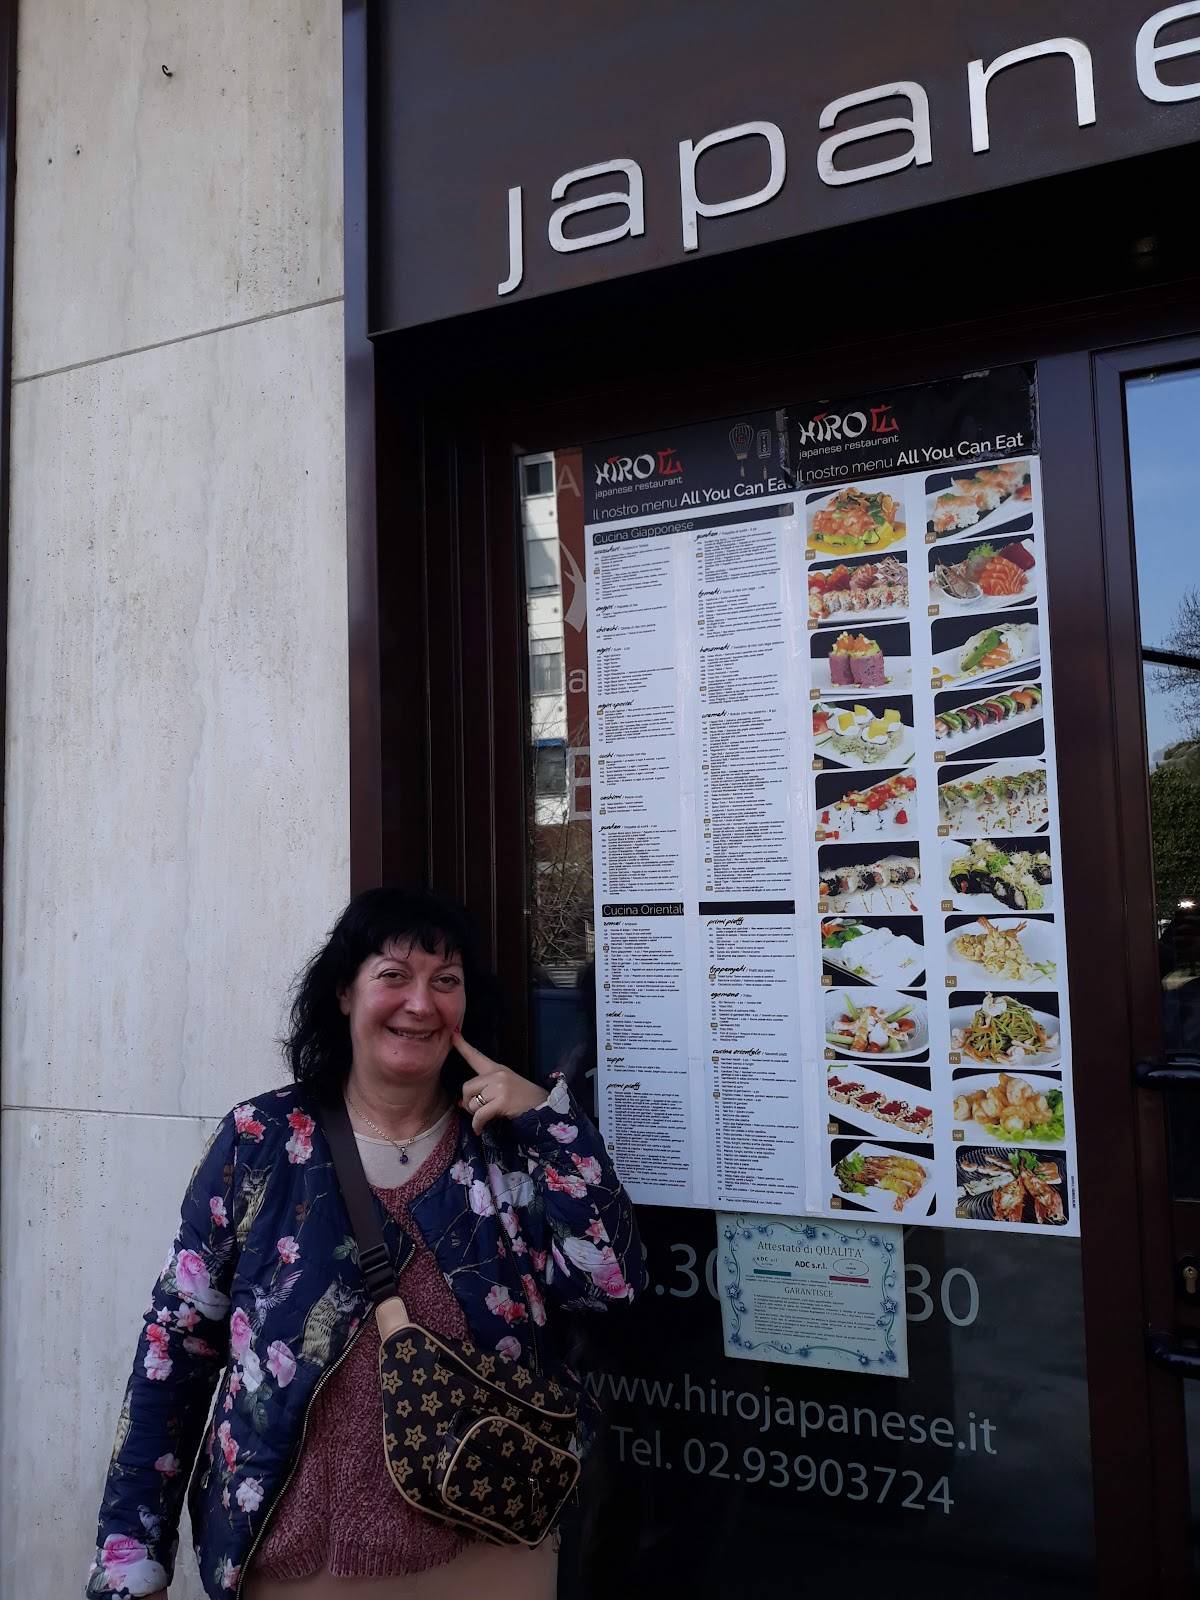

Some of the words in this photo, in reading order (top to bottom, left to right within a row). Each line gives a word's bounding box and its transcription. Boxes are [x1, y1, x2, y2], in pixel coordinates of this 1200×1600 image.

[797, 410, 868, 446] HIRO
[799, 444, 842, 461] japanese
[844, 435, 899, 451] restaurant
[806, 464, 849, 481] nostro
[852, 458, 893, 474] menu
[896, 451, 920, 466] All
[921, 446, 954, 463] You
[957, 439, 991, 456] Can
[995, 431, 1024, 449] Eat
[595, 453, 656, 486] HIRO
[595, 484, 633, 500] japanese
[634, 476, 683, 492] restaurant
[601, 503, 639, 519] nostro
[641, 498, 678, 513] menu
[680, 492, 700, 507] All
[702, 487, 731, 503] You
[734, 482, 764, 498] Can
[593, 531, 629, 545] Cucina
[630, 520, 695, 540] Giapponese
[602, 905, 638, 916] Cucina
[641, 904, 685, 915] Oriental
[757, 1240, 801, 1254] Attestato
[803, 1244, 814, 1255] di
[794, 1260, 811, 1269] ADC
[784, 1286, 834, 1298] GARANTISCE
[611, 1424, 673, 1471] Tel.
[683, 1437, 955, 1515] 02.93903724
